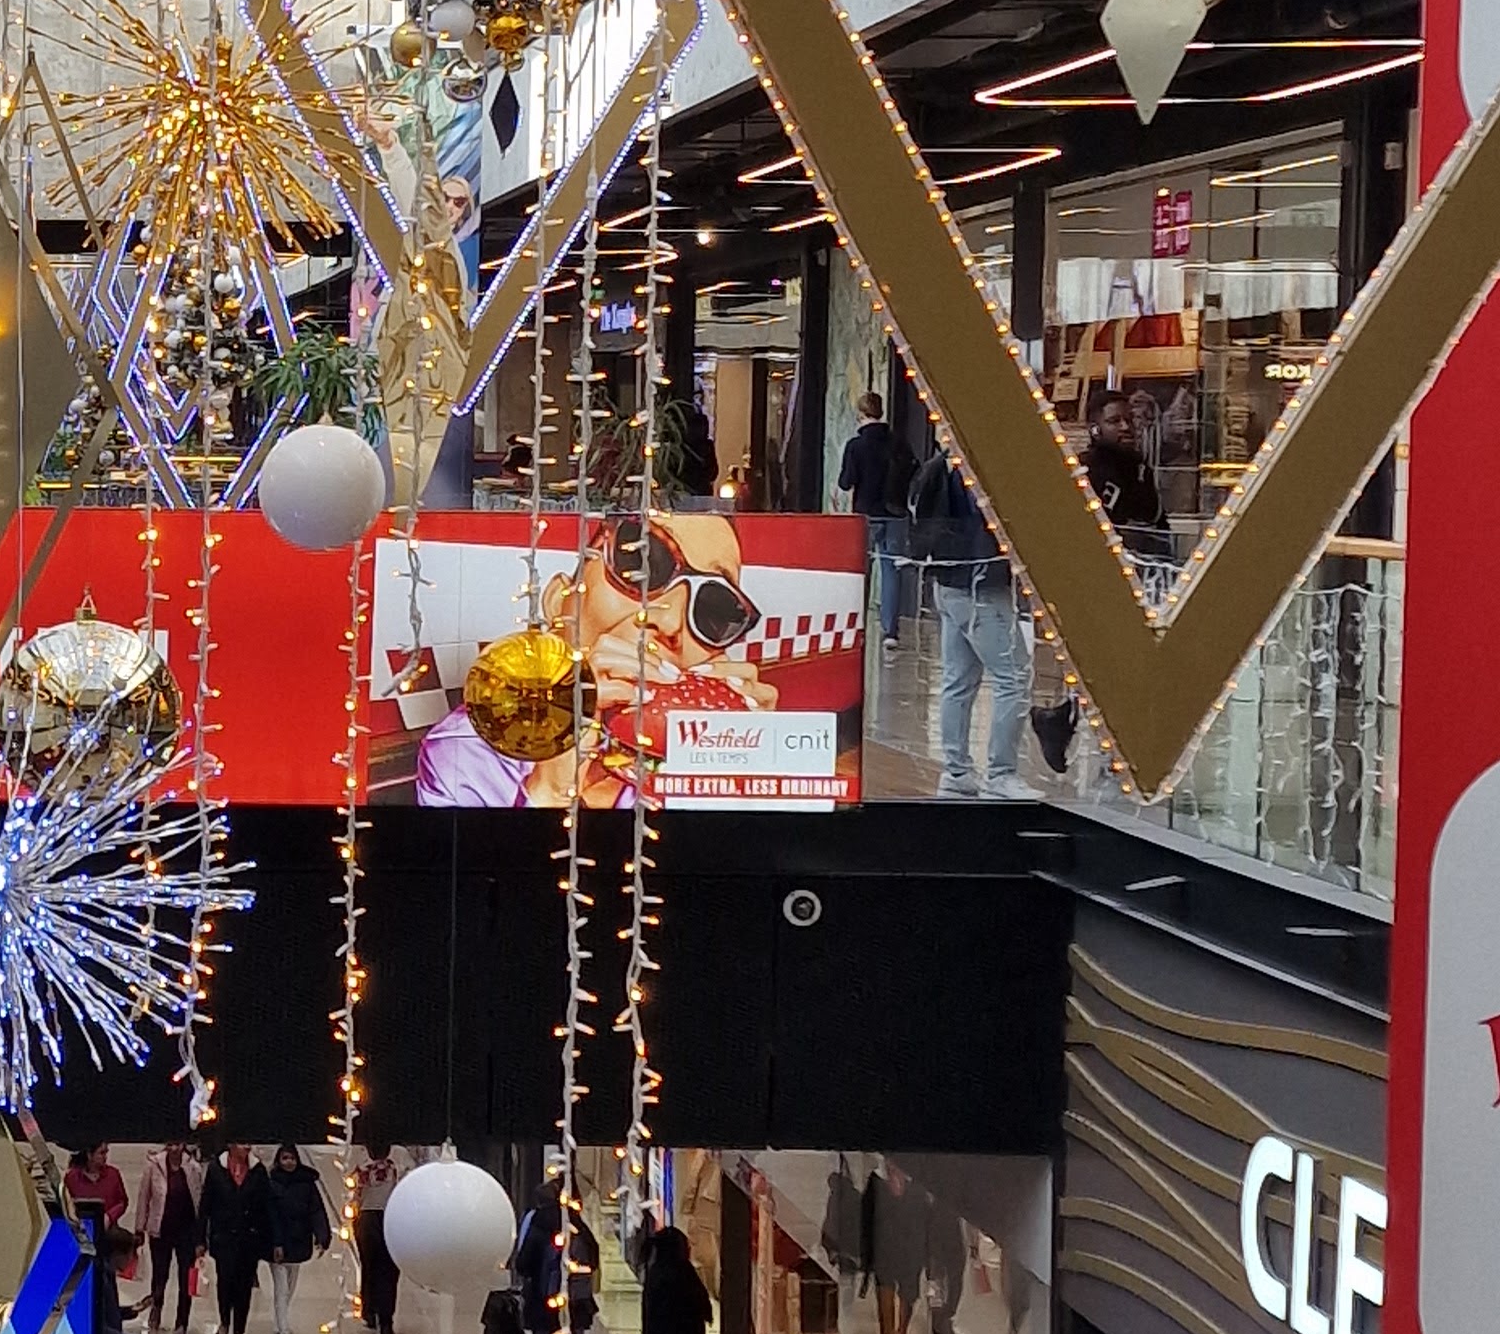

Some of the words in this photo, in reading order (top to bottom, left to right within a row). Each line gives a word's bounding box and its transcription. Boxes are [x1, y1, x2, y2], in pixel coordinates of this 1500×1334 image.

[677, 720, 765, 749] Westfield
[785, 729, 830, 751] cnit
[690, 752, 708, 764] LES
[717, 752, 749, 765] TEMPS
[654, 777, 690, 794] MORE
[745, 779, 778, 795] LESS
[781, 780, 849, 797] ORDINARY
